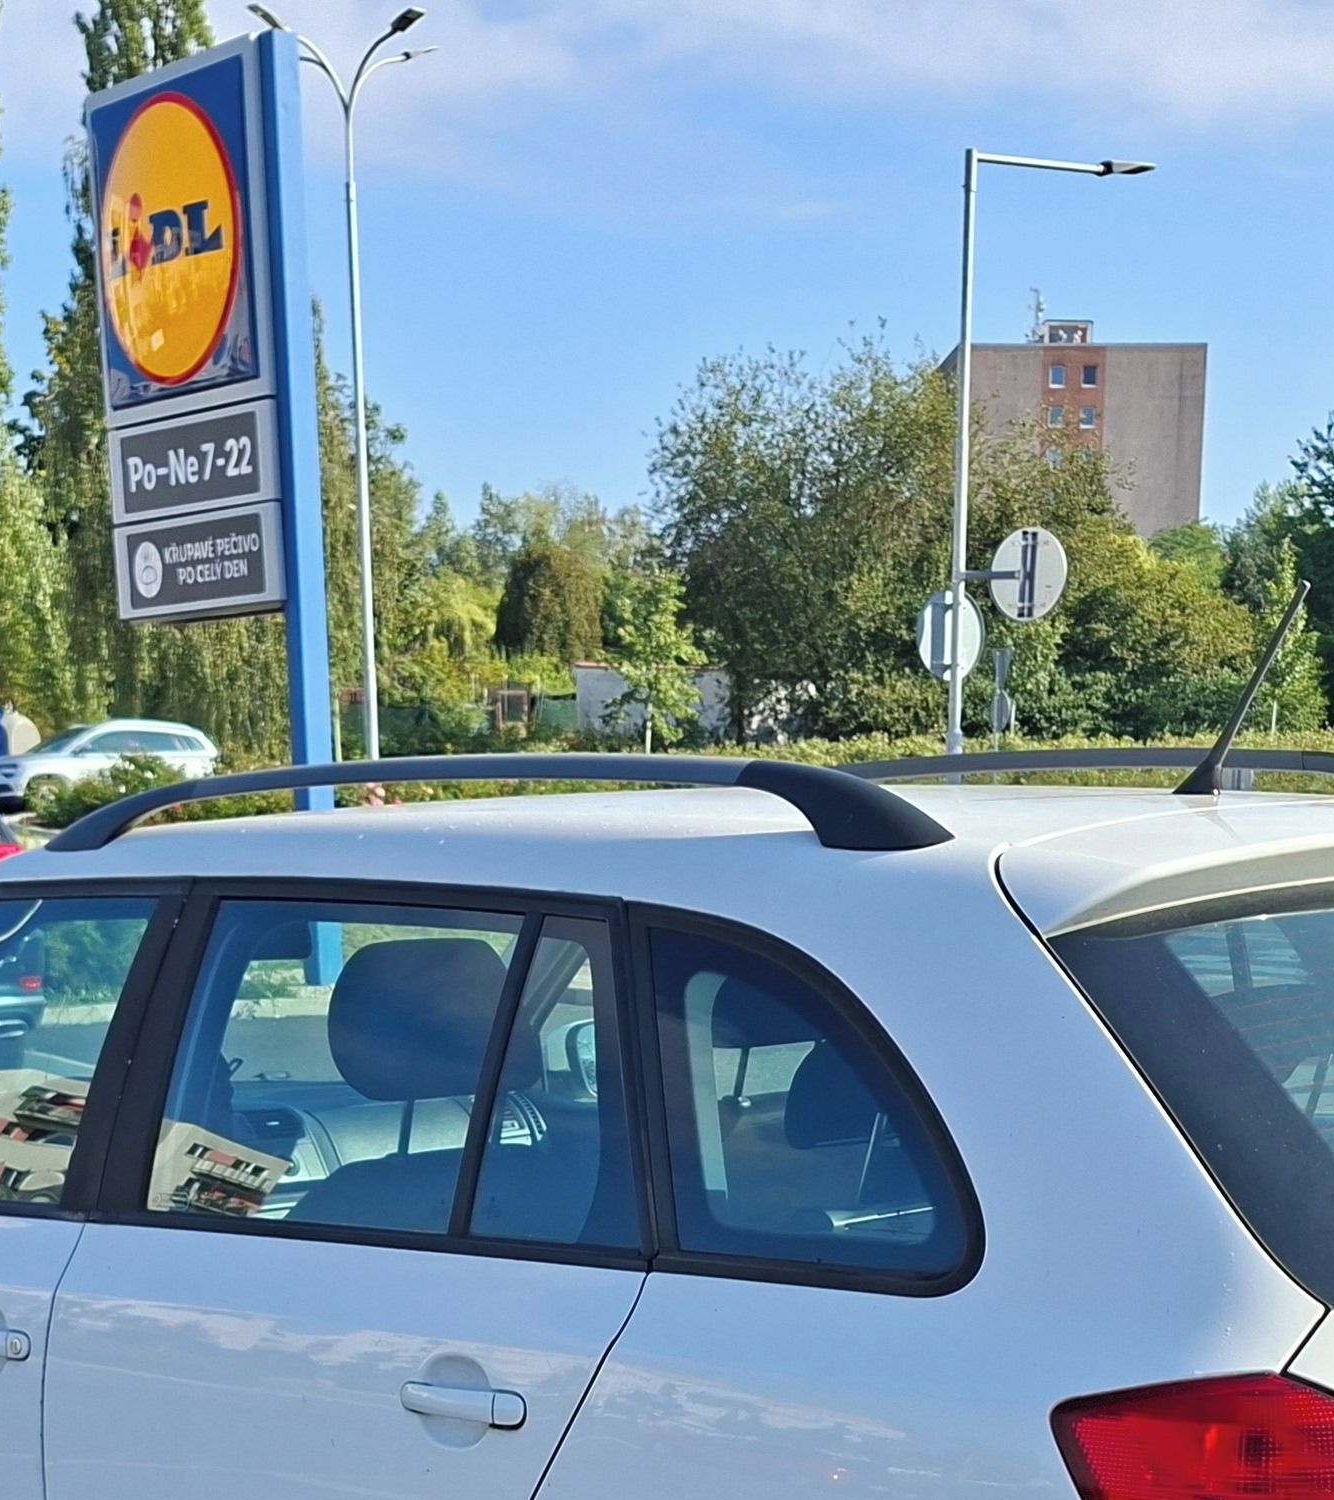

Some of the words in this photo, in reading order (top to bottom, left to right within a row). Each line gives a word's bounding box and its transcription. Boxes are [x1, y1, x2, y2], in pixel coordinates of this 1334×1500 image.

[127, 448, 200, 493] Po-Ne
[200, 436, 253, 482] 7-22
[164, 536, 214, 565] KŘUPAVÉ
[216, 532, 260, 557] PEČIVO
[176, 566, 195, 586] PO
[196, 559, 223, 583] CELÝ
[223, 558, 248, 580] DEN
